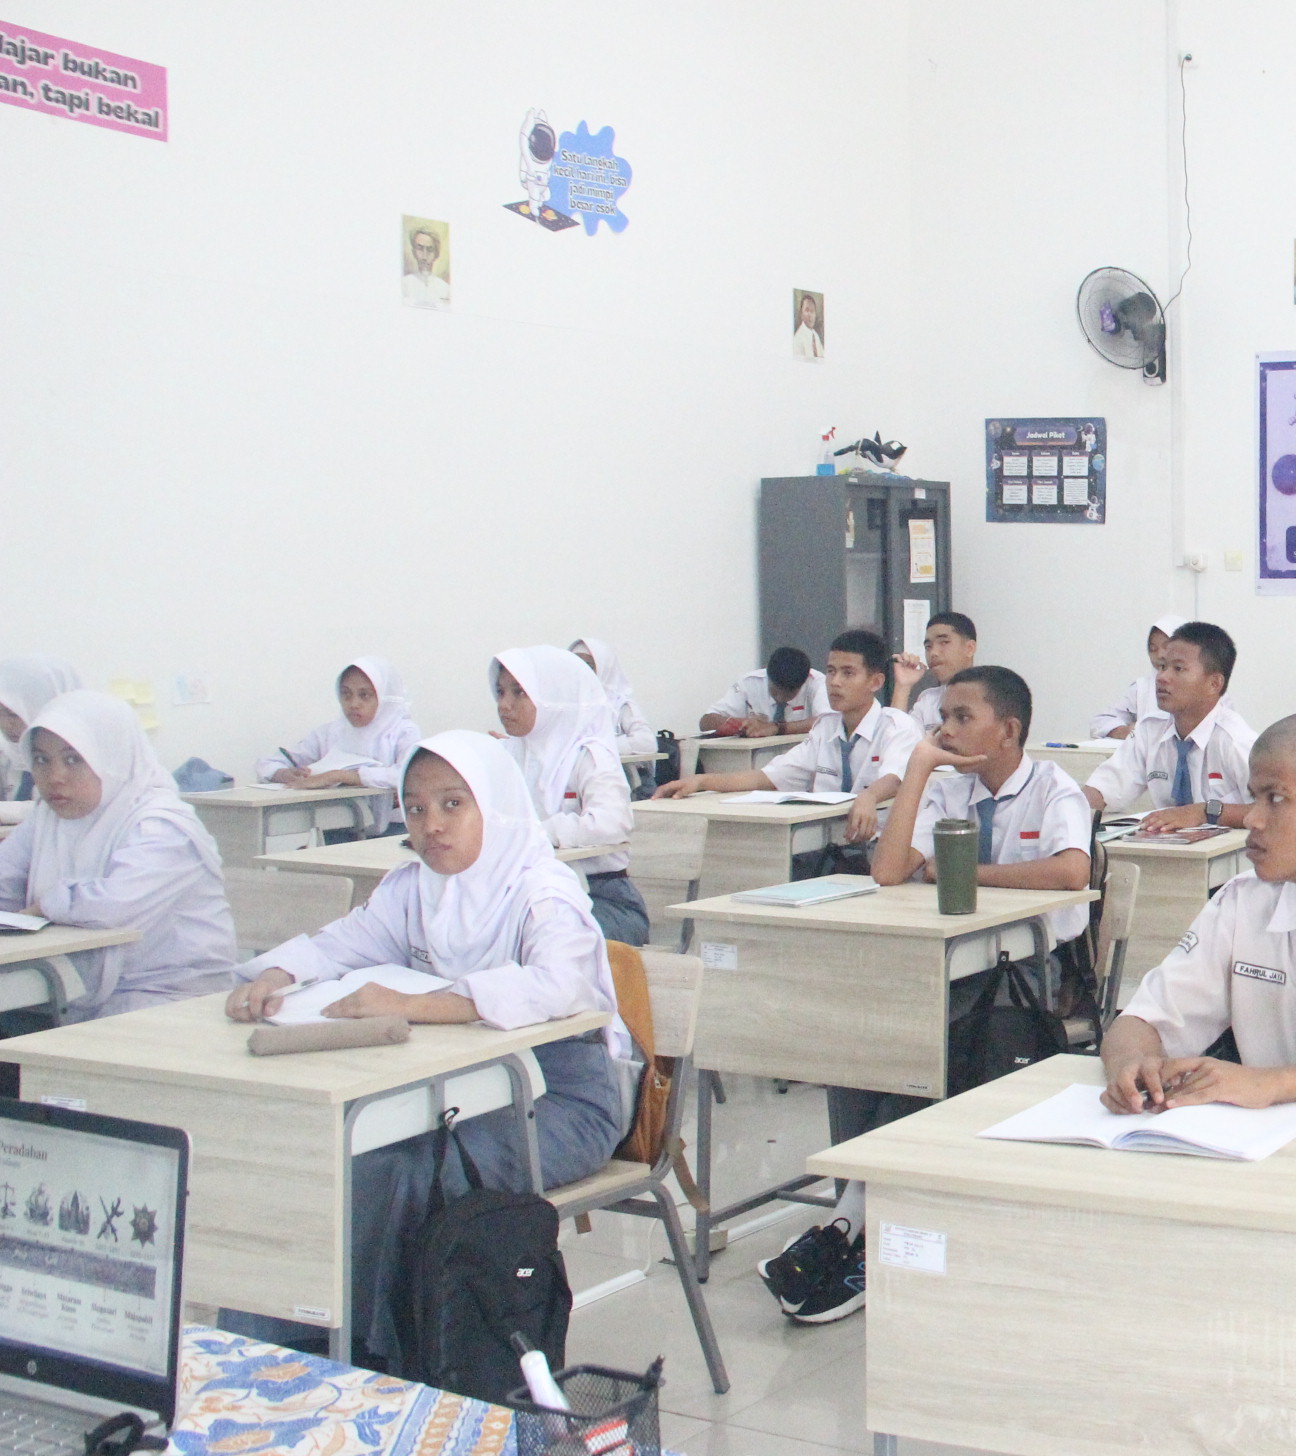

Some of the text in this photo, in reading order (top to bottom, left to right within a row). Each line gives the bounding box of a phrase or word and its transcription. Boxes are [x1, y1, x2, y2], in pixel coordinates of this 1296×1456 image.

[62, 52, 138, 89] bukan
[41, 83, 90, 113] tapi
[98, 96, 159, 128] bekal
[1026, 431, 1066, 439] Jadwal Piket
[1240, 965, 1267, 977] FAHRUL
[516, 1267, 535, 1277] acer
